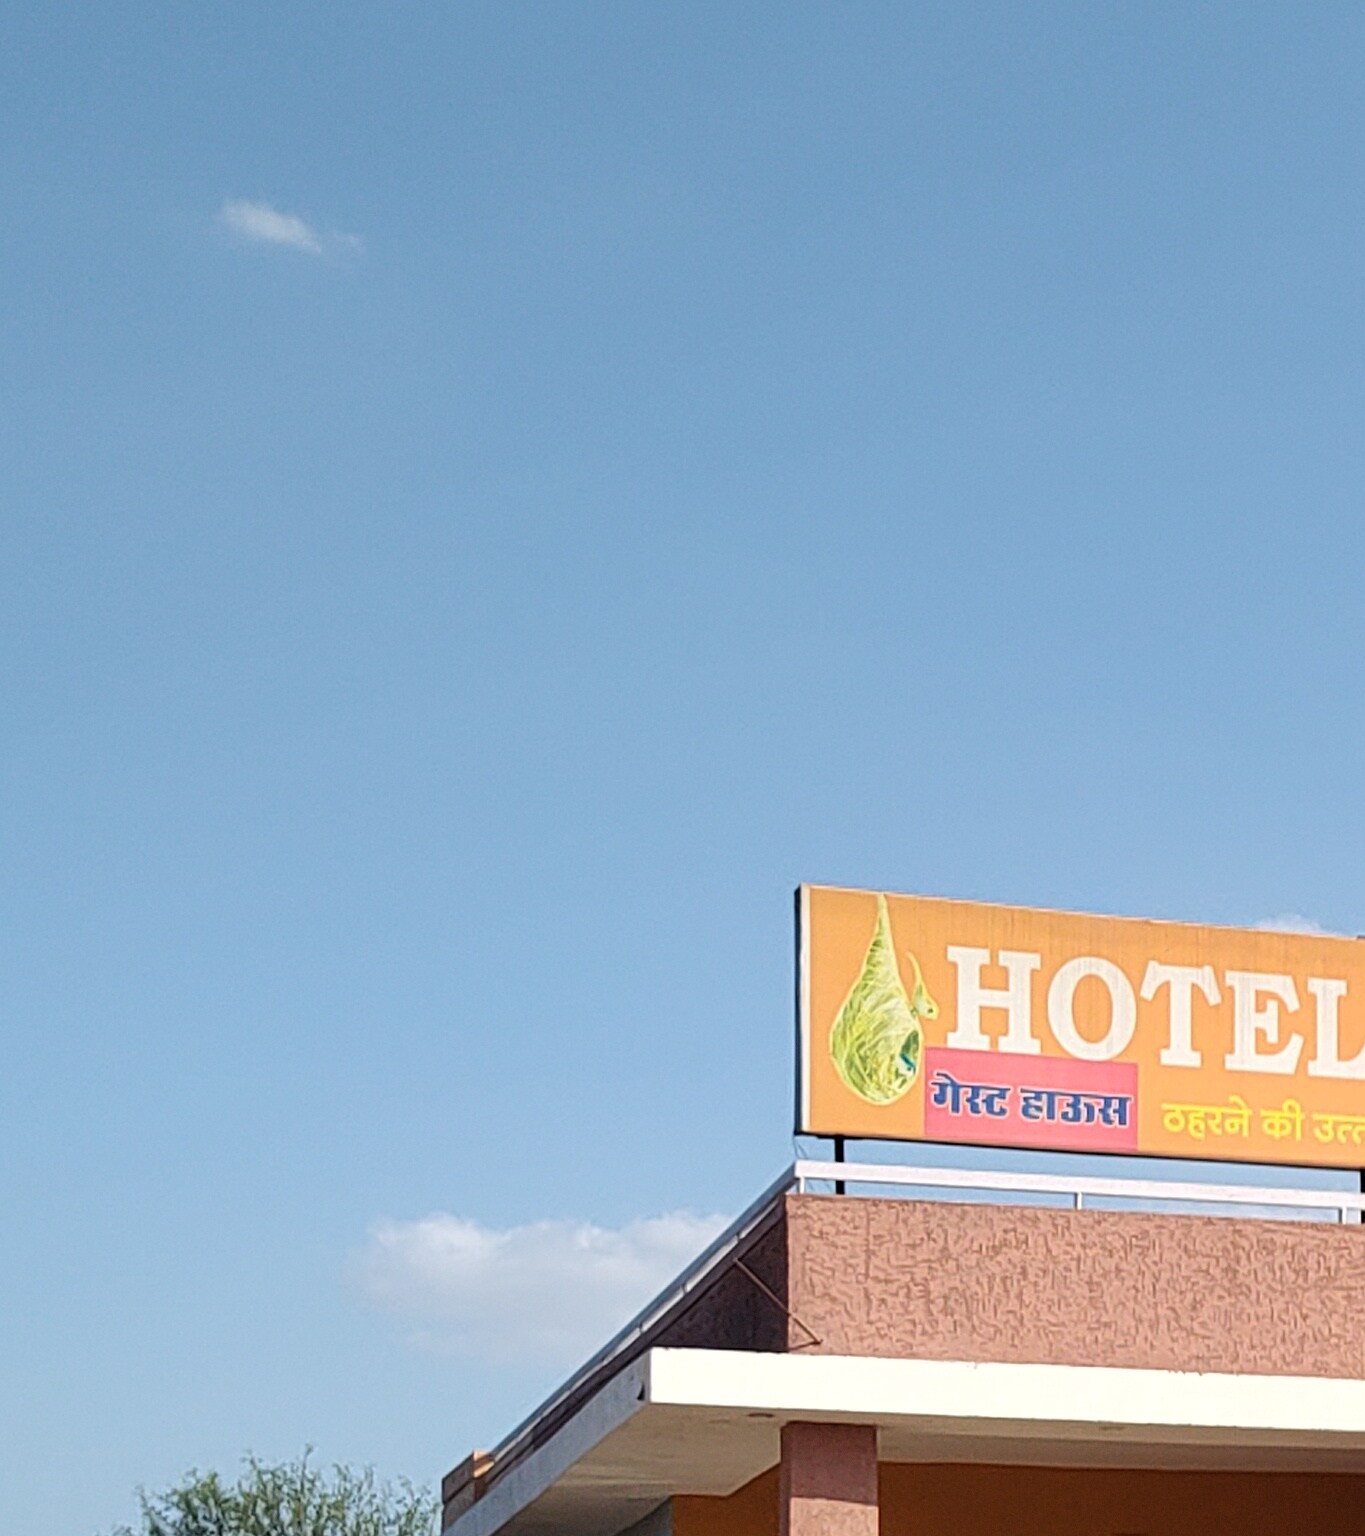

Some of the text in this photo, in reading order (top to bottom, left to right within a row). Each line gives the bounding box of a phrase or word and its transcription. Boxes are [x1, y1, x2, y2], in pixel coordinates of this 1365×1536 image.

[929, 1070, 1133, 1127] गेस्ट हाऊस
[1160, 1095, 1252, 1140] ठहरने
[1260, 1098, 1304, 1142] की
